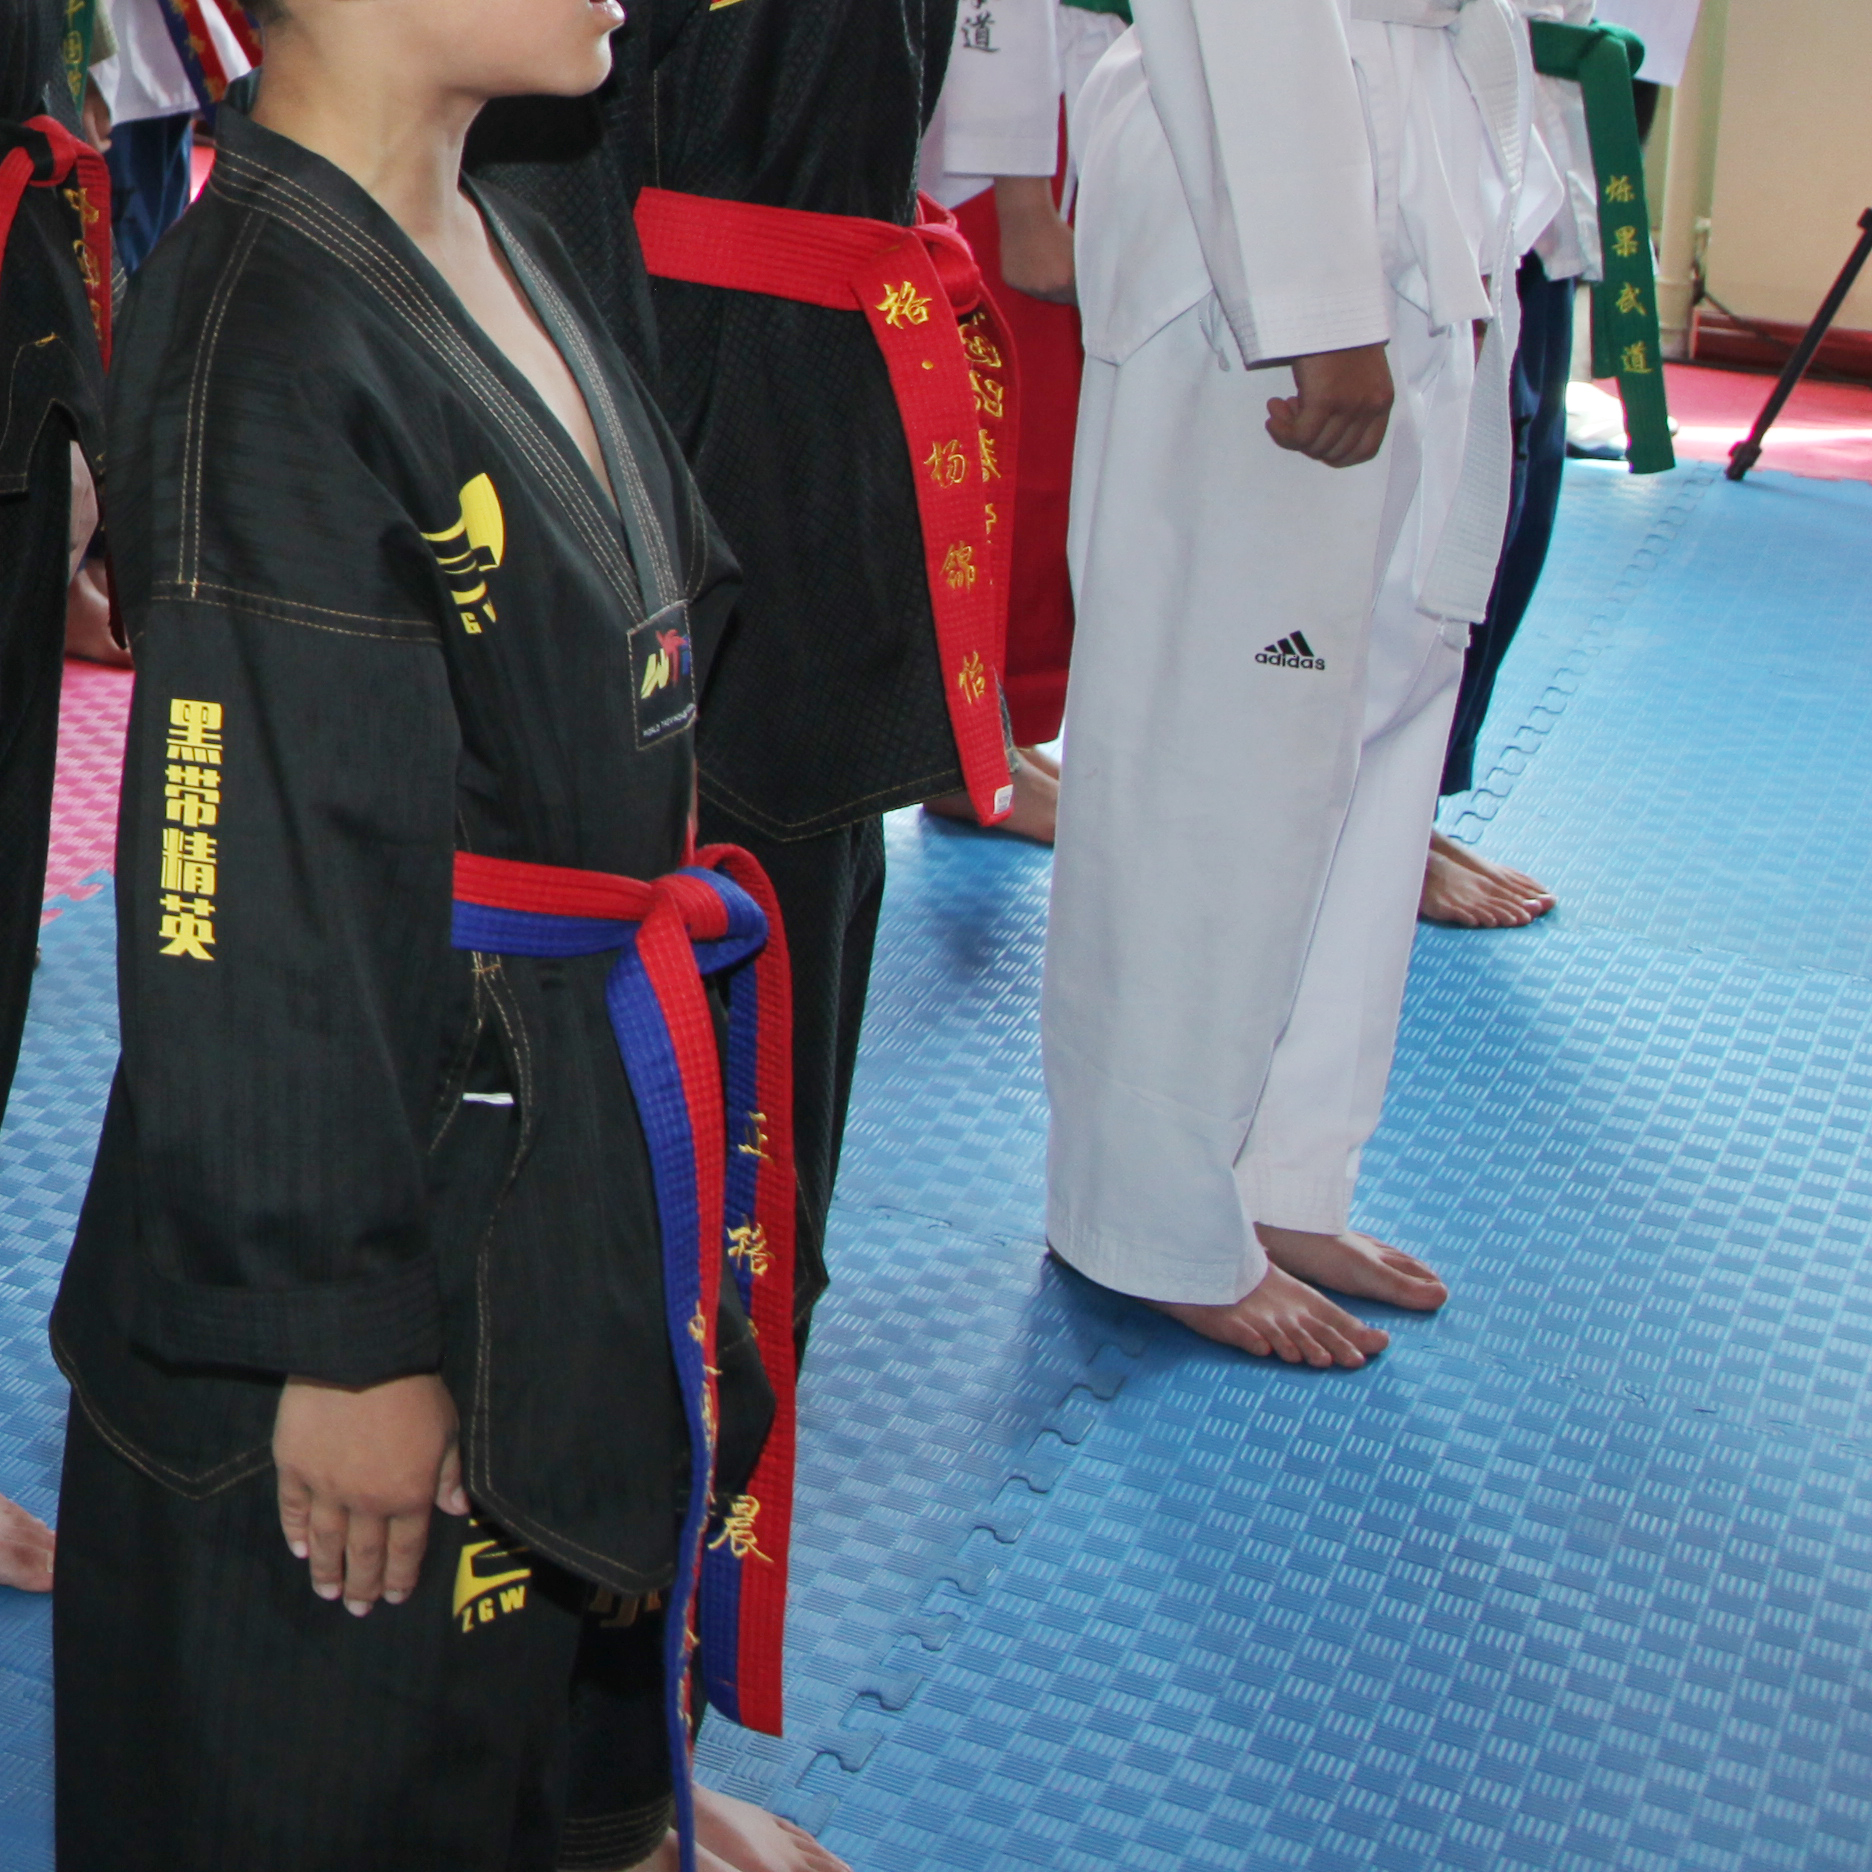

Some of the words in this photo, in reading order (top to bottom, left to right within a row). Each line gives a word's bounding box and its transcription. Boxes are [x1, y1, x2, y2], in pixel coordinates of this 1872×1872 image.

[1254, 650, 1326, 671] adidas
[158, 698, 224, 961] 黑带精英
[461, 1584, 527, 1634] ZGW
